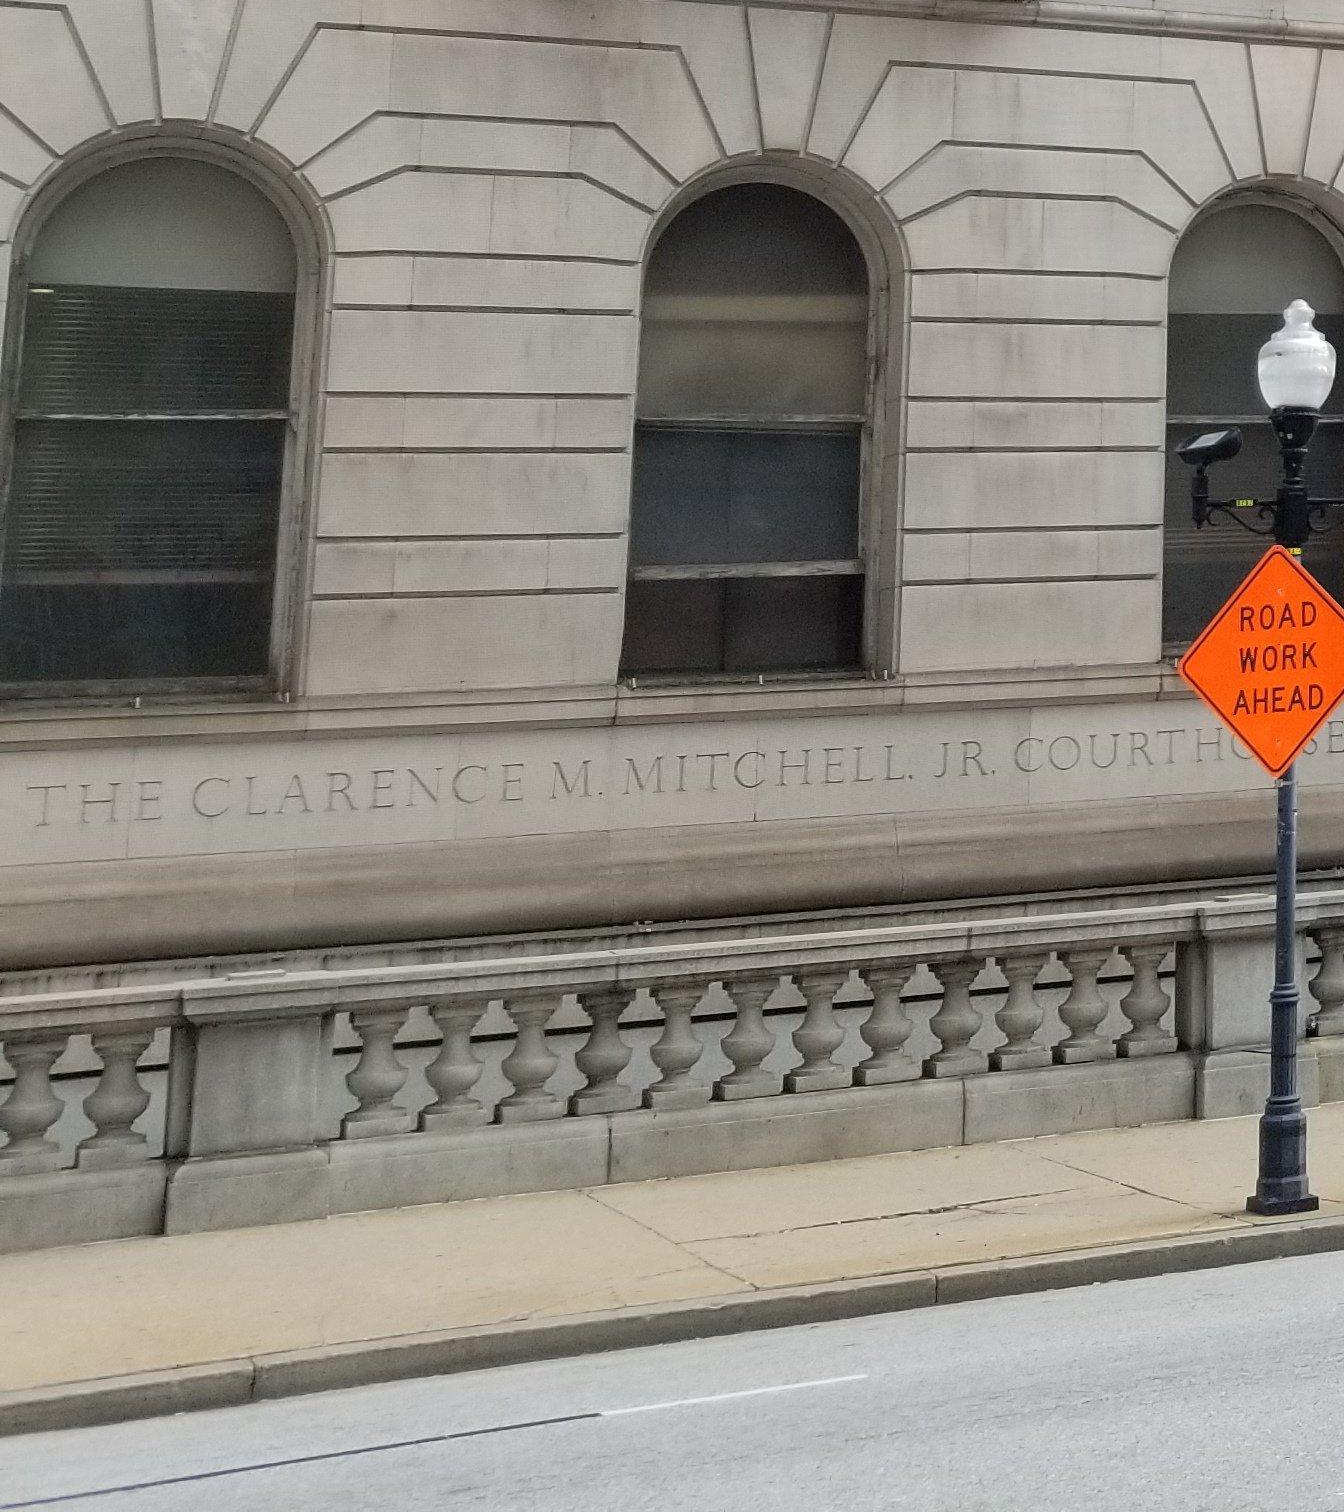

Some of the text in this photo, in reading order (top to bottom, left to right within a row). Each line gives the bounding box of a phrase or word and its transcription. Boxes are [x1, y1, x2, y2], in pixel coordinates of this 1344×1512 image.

[1239, 601, 1317, 632] ROAD
[1239, 642, 1318, 674] WORK
[1232, 683, 1324, 716] AHEAD
[26, 781, 163, 827] THE
[192, 762, 525, 818] CLARENCE
[550, 759, 603, 799] M.
[934, 740, 996, 778] JR.
